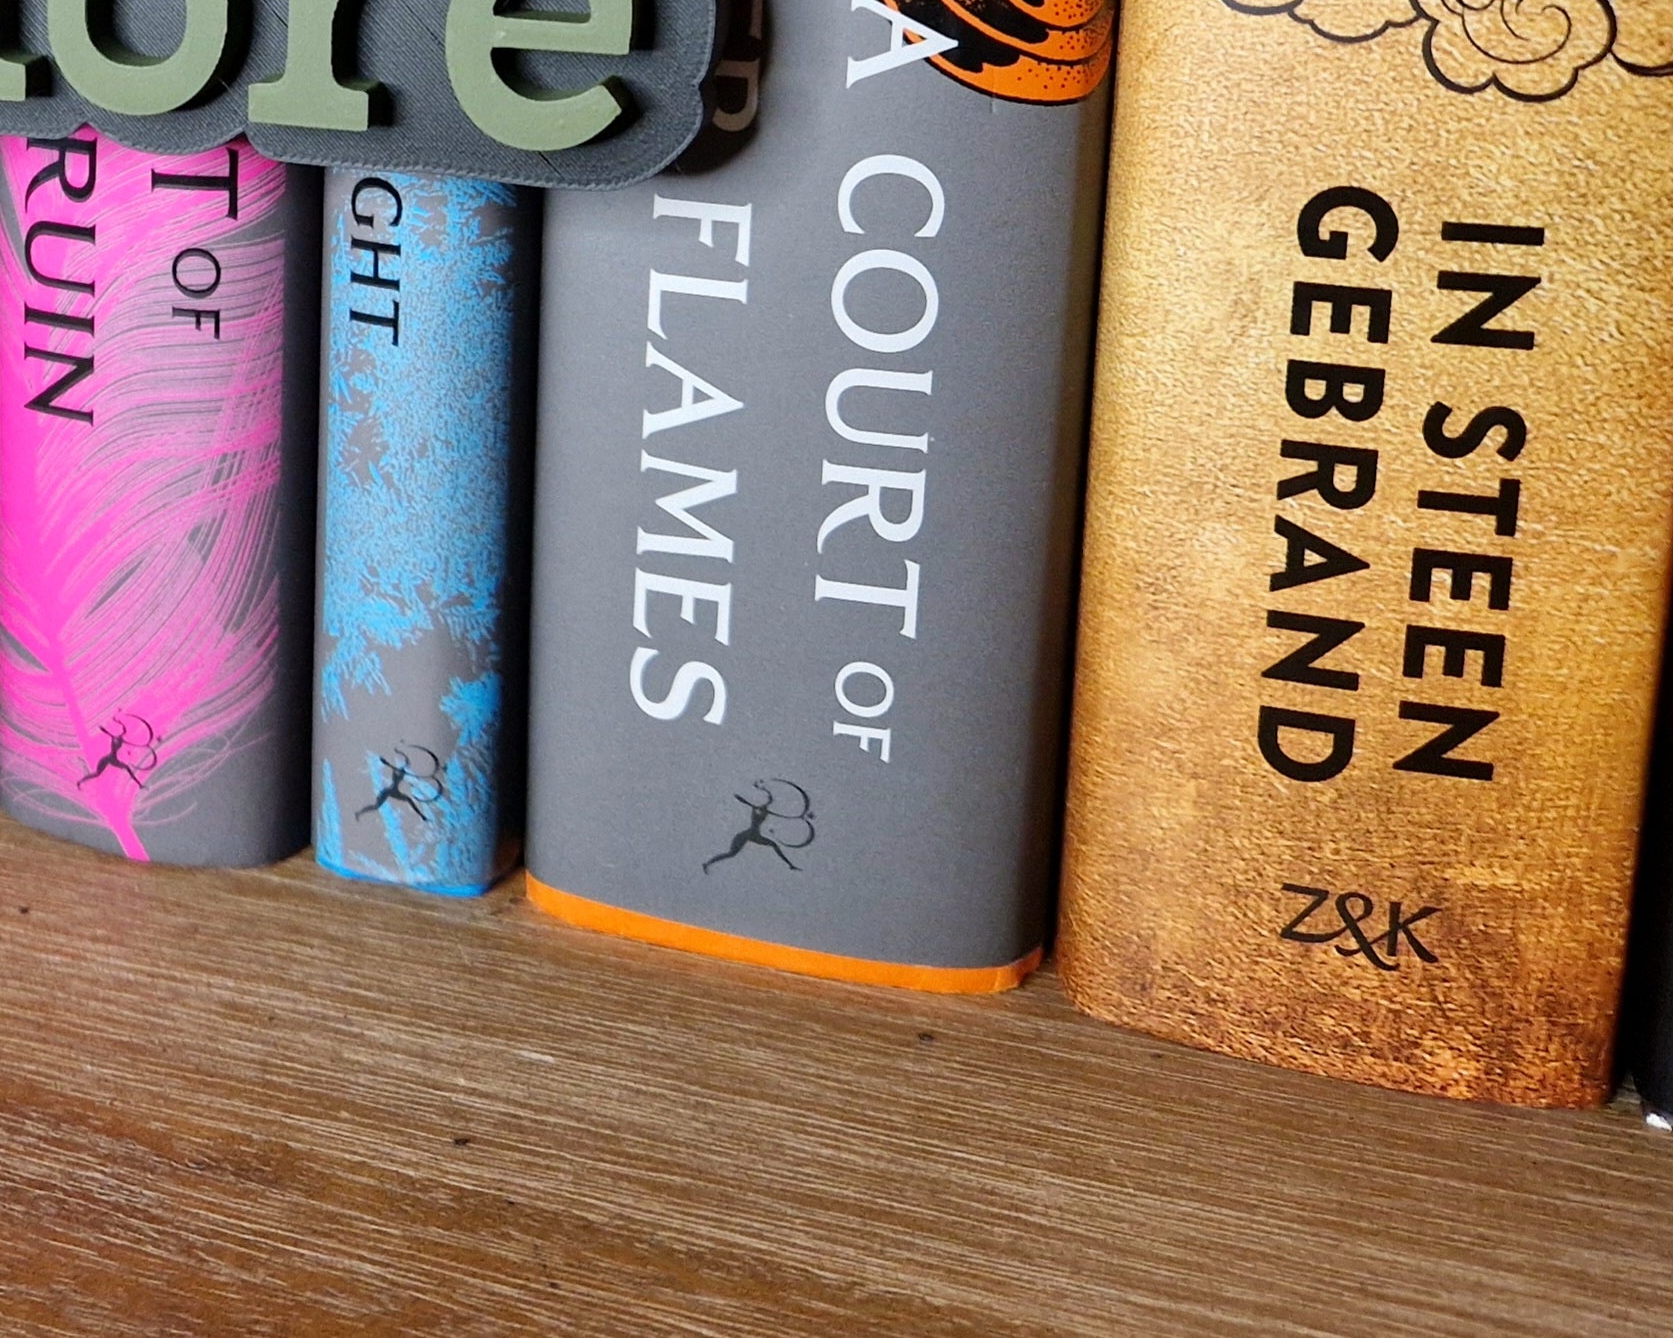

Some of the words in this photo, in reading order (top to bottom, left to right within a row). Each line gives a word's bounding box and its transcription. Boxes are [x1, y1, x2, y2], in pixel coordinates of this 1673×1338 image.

[23, 136, 98, 427] RUIN
[171, 247, 221, 341] OF
[814, 154, 945, 639] COURT
[1430, 220, 1546, 352] IN
[629, 193, 752, 726] FLAMES
[1257, 185, 1399, 784] GEBRAND
[1393, 400, 1528, 783] STEEN
[832, 662, 894, 763] OF
[1278, 883, 1442, 972] Z&K
